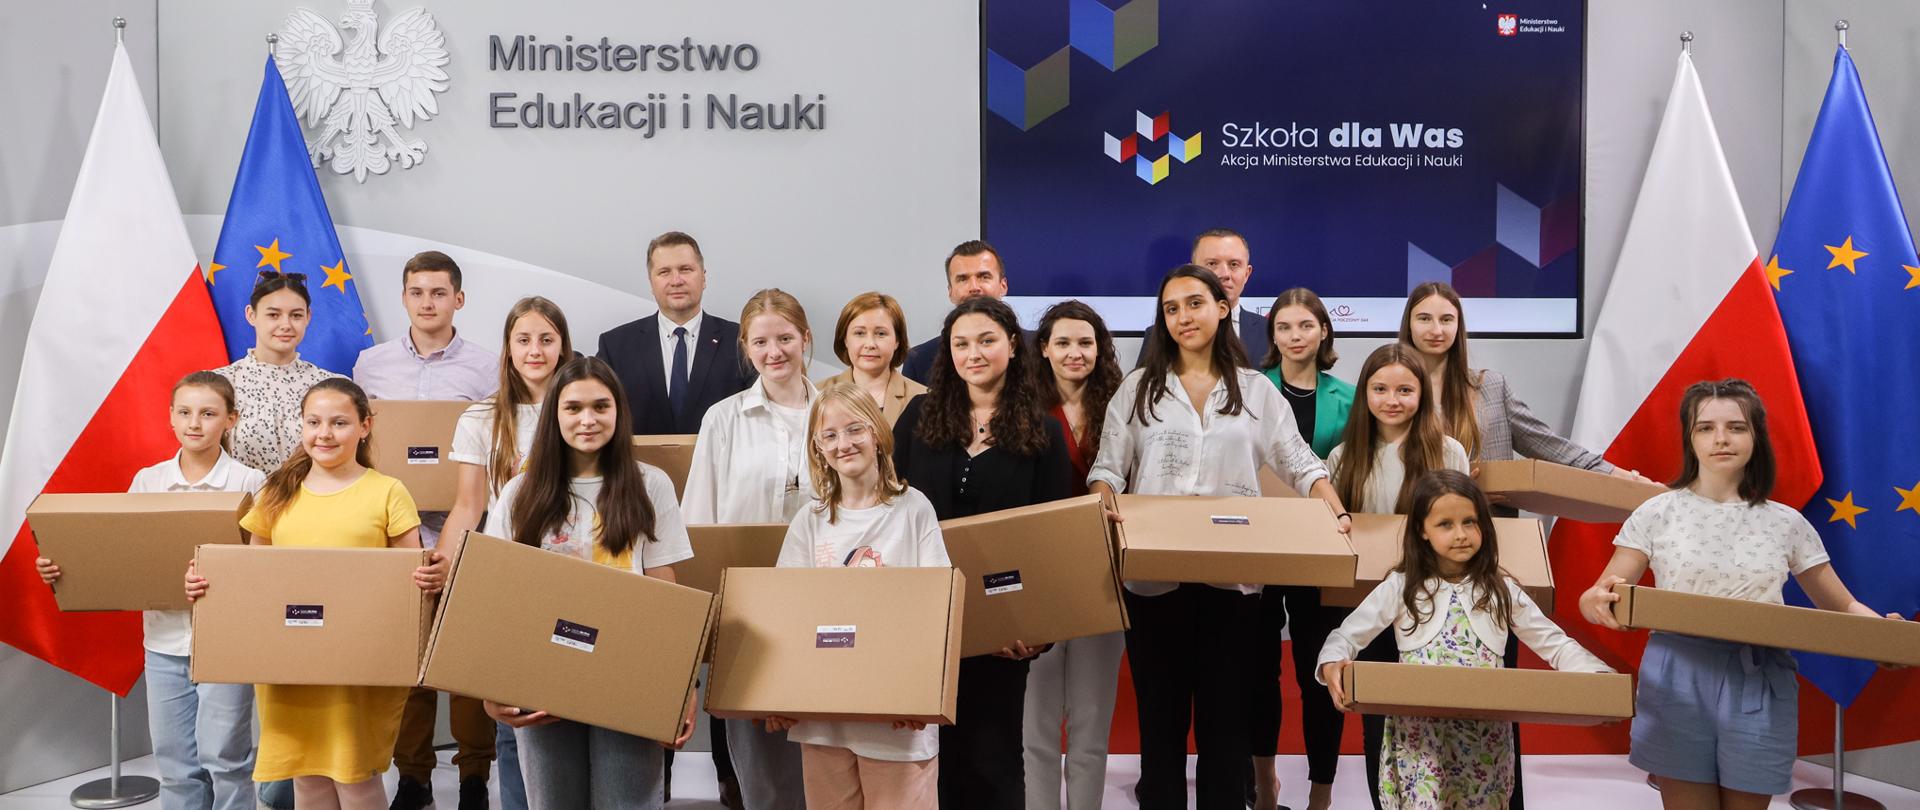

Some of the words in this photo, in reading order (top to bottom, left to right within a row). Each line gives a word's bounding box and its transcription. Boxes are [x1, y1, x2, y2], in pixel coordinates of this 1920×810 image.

[1520, 26, 1543, 34] Edukacji
[488, 34, 761, 72] Ministerstwo
[489, 92, 667, 139] Edukacji
[682, 93, 690, 130] i
[706, 93, 827, 130] Nauki
[1222, 121, 1318, 148] Szkoła
[1329, 121, 1382, 148] dla
[1389, 123, 1464, 148] Was
[1221, 154, 1259, 169] Akcja
[1263, 154, 1351, 167] Ministerstwa
[1355, 154, 1413, 170] Edukacji
[1424, 154, 1463, 167] Nauki
